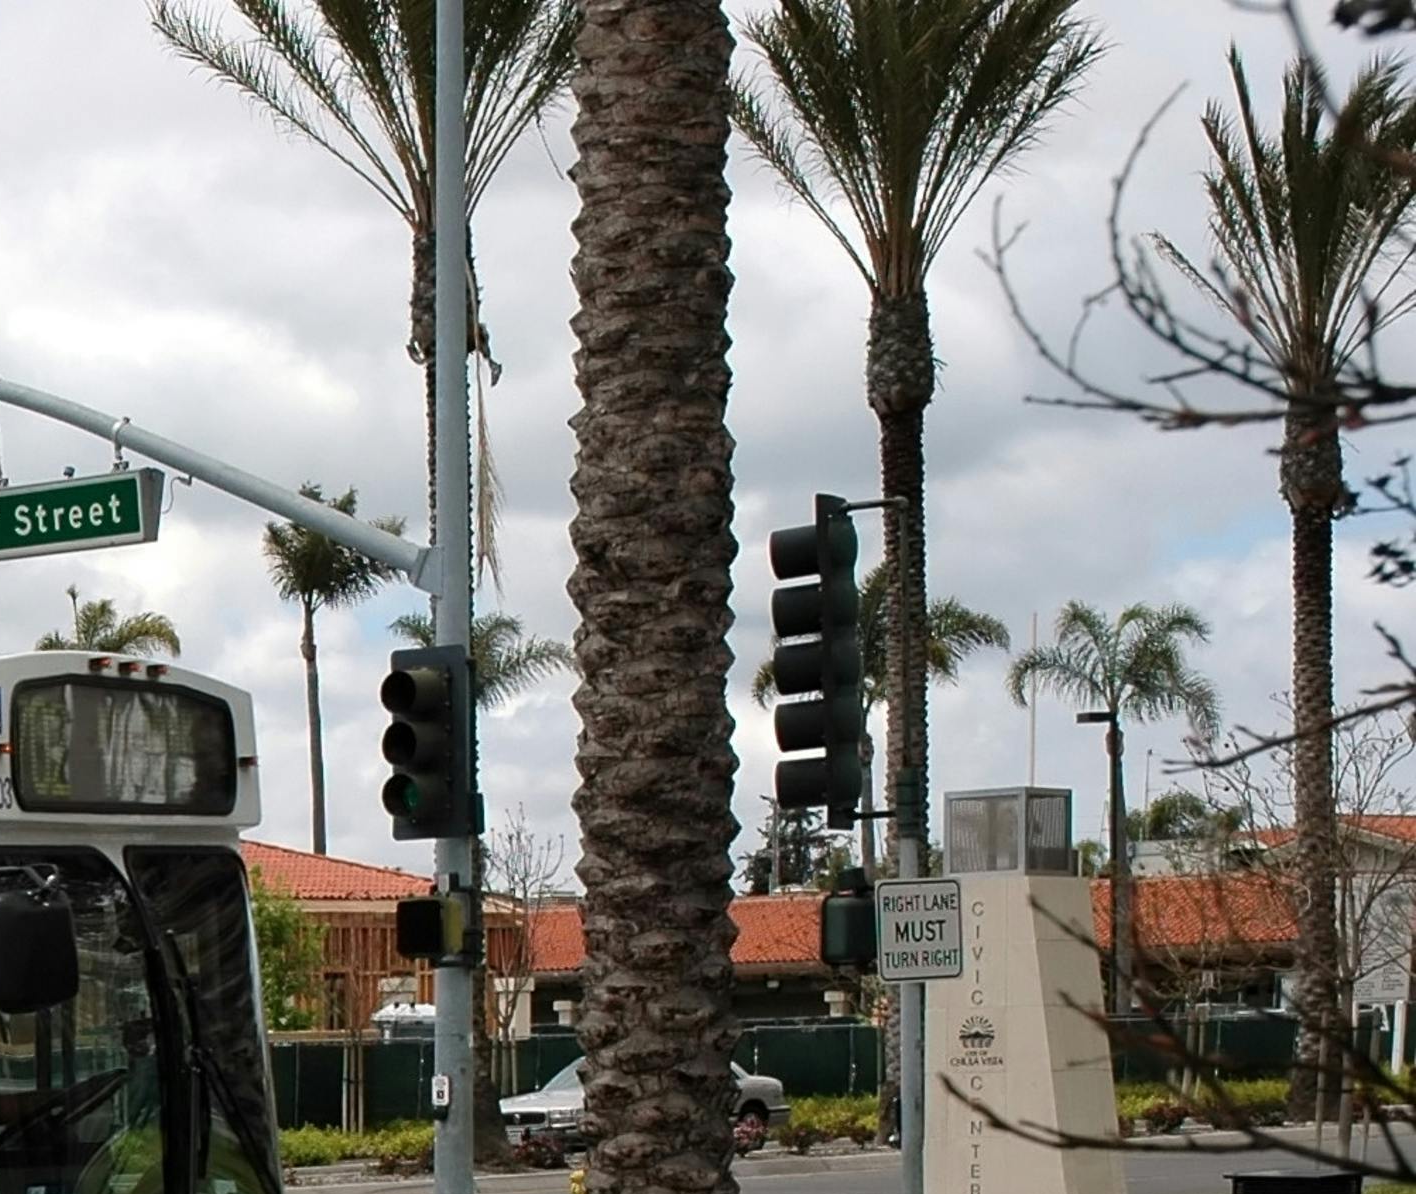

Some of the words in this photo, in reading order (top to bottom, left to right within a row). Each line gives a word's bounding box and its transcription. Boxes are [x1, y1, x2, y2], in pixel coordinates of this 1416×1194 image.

[14, 493, 122, 537] Street
[883, 895, 920, 912] RIGHT
[923, 893, 957, 911] LANE
[895, 919, 946, 943] MUST
[884, 951, 919, 968] TURN
[921, 948, 958, 967] RIGHT
[971, 901, 985, 1006] CIVIC
